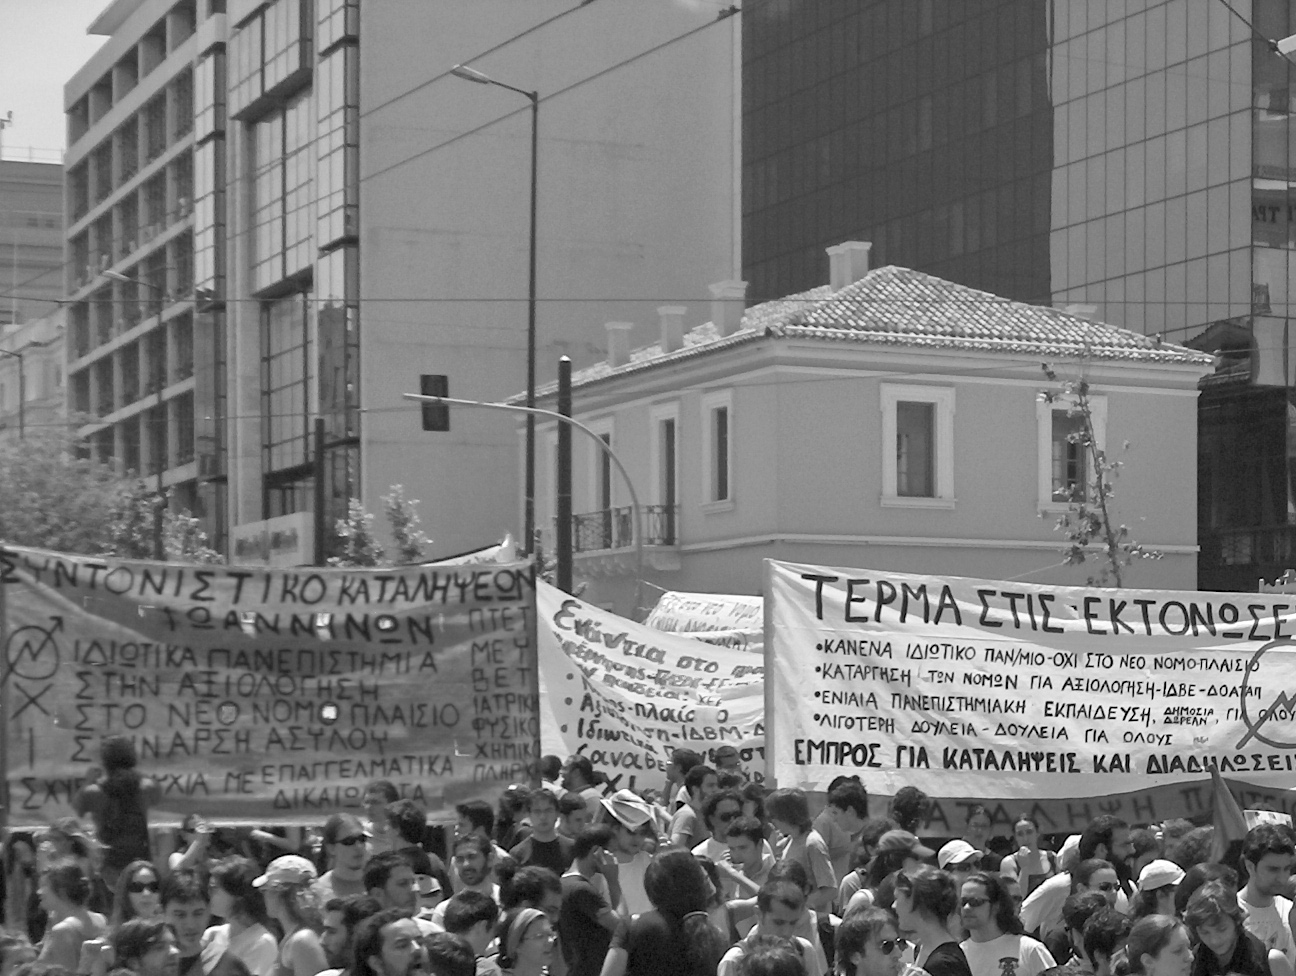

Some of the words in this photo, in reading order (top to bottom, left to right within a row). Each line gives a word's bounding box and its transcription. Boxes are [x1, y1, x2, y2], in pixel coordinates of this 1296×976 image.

[1, 552, 326, 605] ΣΥΝΤΟΝΙΣΤΙΚΟ
[338, 564, 536, 606] ΚΑΤΑΛΗΨΕΩΝ
[802, 574, 963, 626] ΤΕΡΜΑ
[977, 589, 1065, 634] ΣΤΙΣ
[74, 640, 197, 668] ΙΔΙΩΤΙΚΑ
[208, 648, 438, 674] ΠΑΝΕΠΙΣΤΗΜΙΑ
[824, 639, 893, 660] ΚΑΝΕΝΑ
[906, 643, 977, 661] ΙΔΙΩΤΙΚΟ
[1085, 653, 1114, 669] ΣΤΟ
[1119, 654, 1146, 670] ΝΕΟ
[76, 671, 160, 699] ΣΤΗΝ
[178, 671, 378, 701] ΑΞΙΟΛΟΓΗΣΗ
[822, 664, 912, 685] ΚΑΤΑΡΓΗΣΗ
[928, 669, 954, 684] ΤΩΝ
[963, 674, 1018, 690] ΝΟΜΩΝ
[1030, 675, 1054, 690] ΓΙΑ
[75, 703, 147, 732] ΣΤΟ
[169, 701, 240, 727] ΝΕΟ
[253, 699, 340, 726] ΝΟΜΟ
[352, 703, 460, 728] ΠΛΑΙΣΙΟ
[822, 691, 878, 710] ΕΝΙΑΙΑ
[891, 692, 1027, 714] ΠΑΝΕΠΙΣΤΗΜΙΑΚΗ
[266, 727, 388, 757] ΑΣΥΛΟΥ
[819, 713, 895, 734] ΛΙΓΟΤΕΡΗ
[911, 721, 978, 737] ΔΟΥΛΕΙΑ
[994, 723, 1069, 740] ΔΟΥΛΕΙΑ
[1085, 729, 1109, 744] ΓΙΑ
[1123, 732, 1173, 746] ΟΛΟΥΣ
[794, 739, 883, 768] ΕΜΠΡΟΣ
[896, 746, 930, 769] ΓΙΑ
[943, 748, 1081, 774] ΚΑΤΑΛΗΨΕΙΣ
[1093, 754, 1131, 774] ΚΑΙ
[225, 771, 254, 794] ΜΕ
[262, 755, 453, 785] ΕΠΑΓΓΕΛΜΑΤΙΚΑ
[273, 783, 427, 810] ΔΙΚΑΙΩΤΑ
